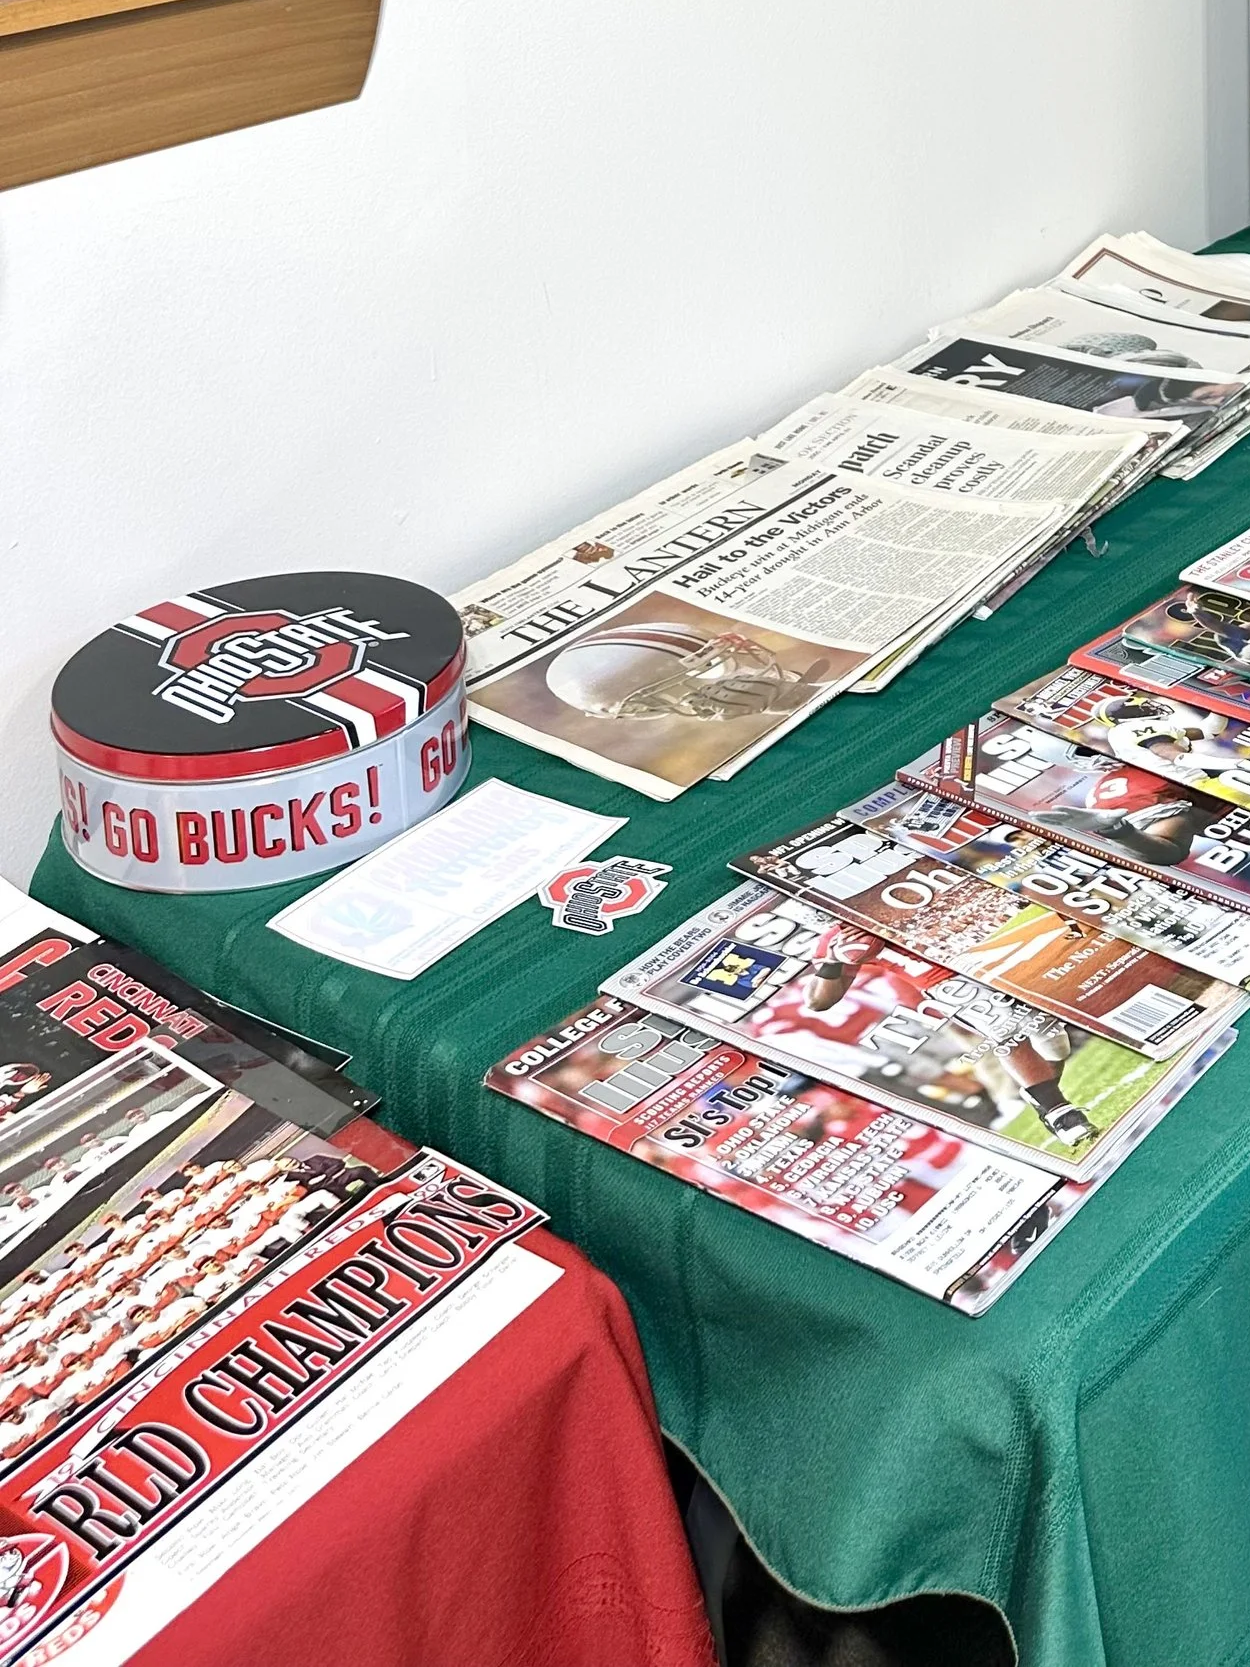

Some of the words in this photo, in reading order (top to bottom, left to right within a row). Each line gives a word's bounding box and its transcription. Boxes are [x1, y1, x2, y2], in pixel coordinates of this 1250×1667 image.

[882, 434, 948, 479] Scandal
[911, 439, 972, 486] cleanup
[932, 451, 986, 491] proves
[958, 460, 1005, 494] costly
[672, 562, 723, 589] Hail
[719, 548, 747, 565] to
[744, 525, 784, 548] the
[777, 486, 853, 526] Victors
[696, 563, 751, 598] Buckeye
[750, 550, 775, 568] win
[776, 540, 790, 552] at
[790, 508, 844, 544] Michigan
[843, 493, 869, 510] ends
[763, 546, 808, 575] drought
[808, 537, 824, 548] in
[824, 520, 851, 538] Ann
[851, 499, 883, 521] Arbor
[1188, 563, 1205, 577] THE
[1204, 542, 1242, 567] STANLEY
[500, 599, 595, 647] THE
[578, 500, 768, 601] LANTERN
[161, 653, 264, 725] OHIO
[223, 608, 412, 675] STATE
[101, 800, 160, 864] GO
[175, 764, 383, 865] BUCKS!
[420, 719, 457, 793] GO
[768, 841, 790, 856] NFL
[788, 822, 835, 848] OPENING
[935, 787, 981, 809] ILLUSTRATED
[983, 804, 1018, 824] PRESENTS
[1026, 823, 1044, 834] OHIO
[1047, 831, 1068, 844] STATE
[1133, 863, 1163, 879] SEASON
[1171, 878, 1204, 897] SPECIAL
[577, 858, 664, 900] STATE
[1015, 857, 1037, 873] the
[562, 883, 608, 933] OHIO
[726, 891, 753, 910] JIMMIE
[880, 867, 970, 911] Oh
[1103, 893, 1152, 926] Shocks
[1119, 916, 1138, 932] To
[1134, 899, 1165, 922] Win
[1137, 902, 1195, 939] National
[1188, 921, 1207, 941] 10
[639, 955, 661, 973] HOW
[659, 945, 678, 960] THE
[674, 926, 701, 948] BEARS
[648, 959, 669, 976] PLAY
[666, 938, 697, 962] COVER
[691, 927, 712, 945] TWO
[1041, 958, 1075, 982] The
[1072, 942, 1101, 964] No.
[87, 963, 208, 1040] CINCINNATI
[1079, 970, 1109, 992] NEXT:
[859, 979, 980, 1056] The
[503, 1007, 613, 1076] COLLEGE
[959, 1037, 994, 1066] Troy
[633, 1090, 687, 1125] SCOUTING
[683, 1054, 731, 1091] REPORTS
[656, 1094, 690, 1119] TEAMS
[687, 1072, 725, 1098] RANKED
[708, 1074, 778, 1111] Top
[715, 1128, 755, 1156] OHIO
[750, 1093, 797, 1131] STATE
[721, 1158, 739, 1171] 2.
[735, 1101, 813, 1162] OKLAHOMA
[768, 1137, 816, 1175] TEXAS
[769, 1178, 789, 1193] 5.
[782, 1135, 845, 1184] GEORGIA
[801, 1141, 862, 1194] VIRGINIA
[854, 1112, 895, 1143] TECH
[817, 1152, 874, 1200] KANSAS
[866, 1118, 913, 1156] STATE
[858, 1145, 906, 1185] STATE
[836, 1209, 857, 1224] 9.
[850, 1164, 910, 1214] AUBURN
[854, 1216, 876, 1231] 10.
[871, 1190, 906, 1219] USC
[97, 1267, 290, 1434] CINCINNATI
[304, 1205, 388, 1259] REDS
[183, 1173, 524, 1437] CHAMPIONS
